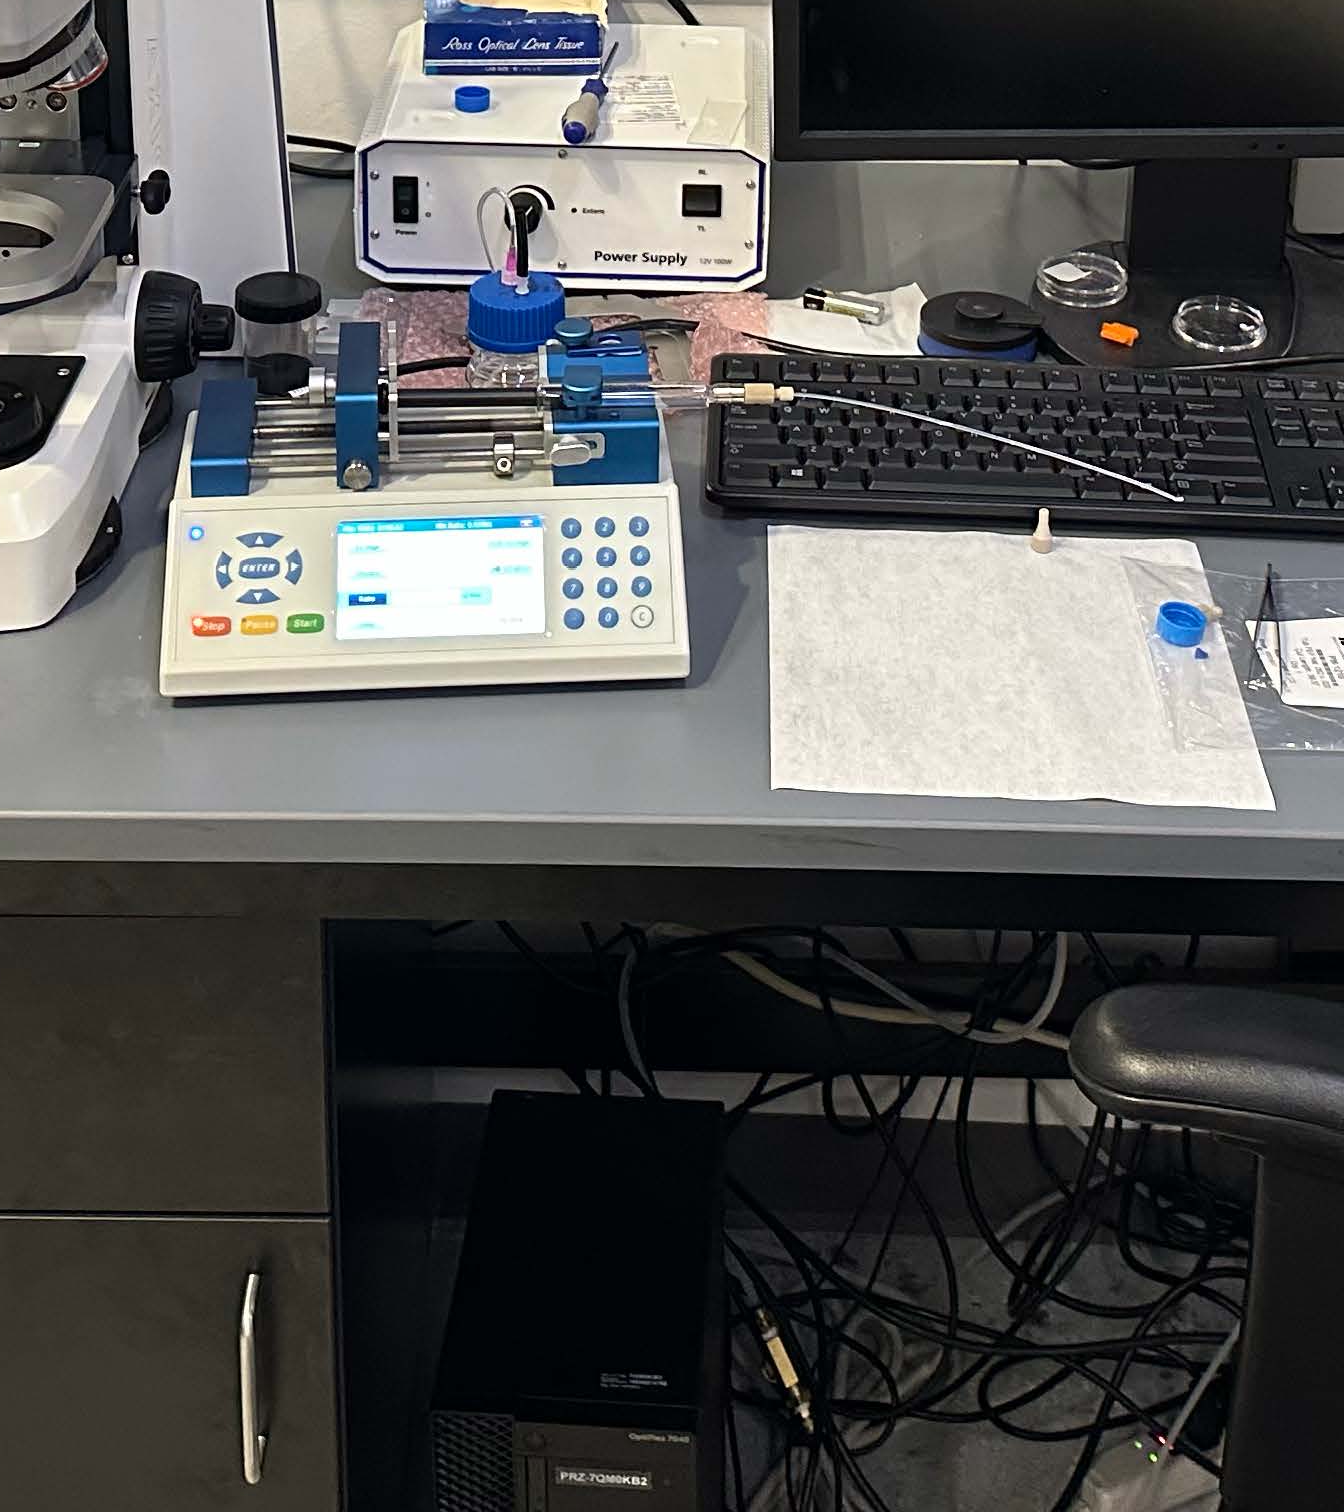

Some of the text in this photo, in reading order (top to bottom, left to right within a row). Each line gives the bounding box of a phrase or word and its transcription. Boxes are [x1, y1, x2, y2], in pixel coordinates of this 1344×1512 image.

[441, 36, 585, 54] Ross Optical Lens Tissue
[593, 250, 688, 267] Power Supply
[699, 257, 712, 265] 12V
[882, 448, 890, 456] C
[601, 522, 609, 532] 2
[636, 521, 642, 531] 3
[568, 551, 643, 563] 4 5 6
[241, 563, 276, 573] ENTER
[570, 582, 646, 593] 7 8 9
[604, 611, 646, 622] 0 C
[202, 621, 225, 632] Stop
[293, 618, 318, 628] Start
